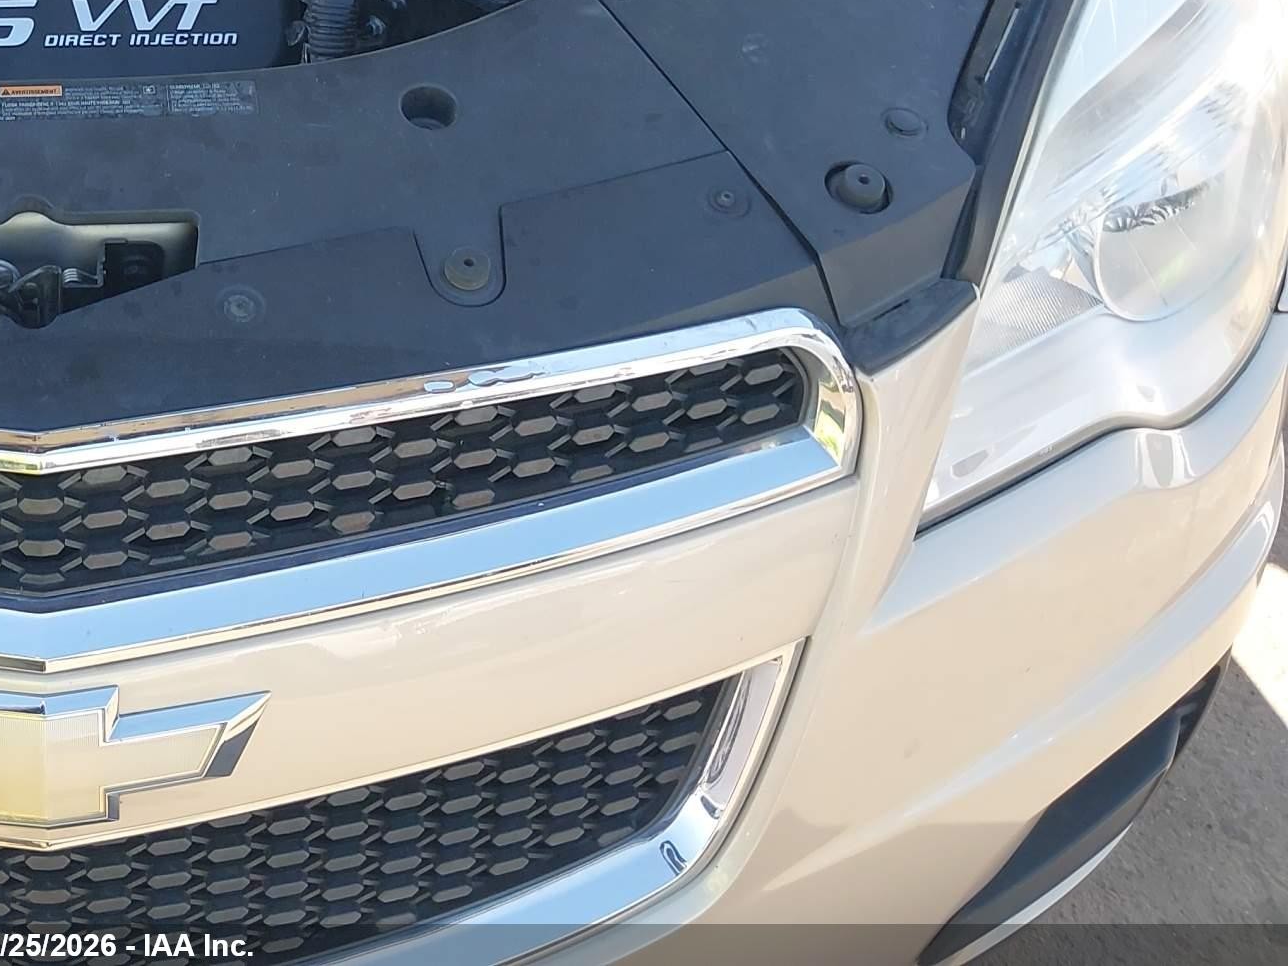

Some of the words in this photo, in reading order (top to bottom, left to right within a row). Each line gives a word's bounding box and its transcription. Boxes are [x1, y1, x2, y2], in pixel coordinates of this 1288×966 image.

[44, 33, 122, 47] DIRECT
[128, 32, 238, 46] INJECTION
[11, 88, 57, 96] AVERTISSEMENT
